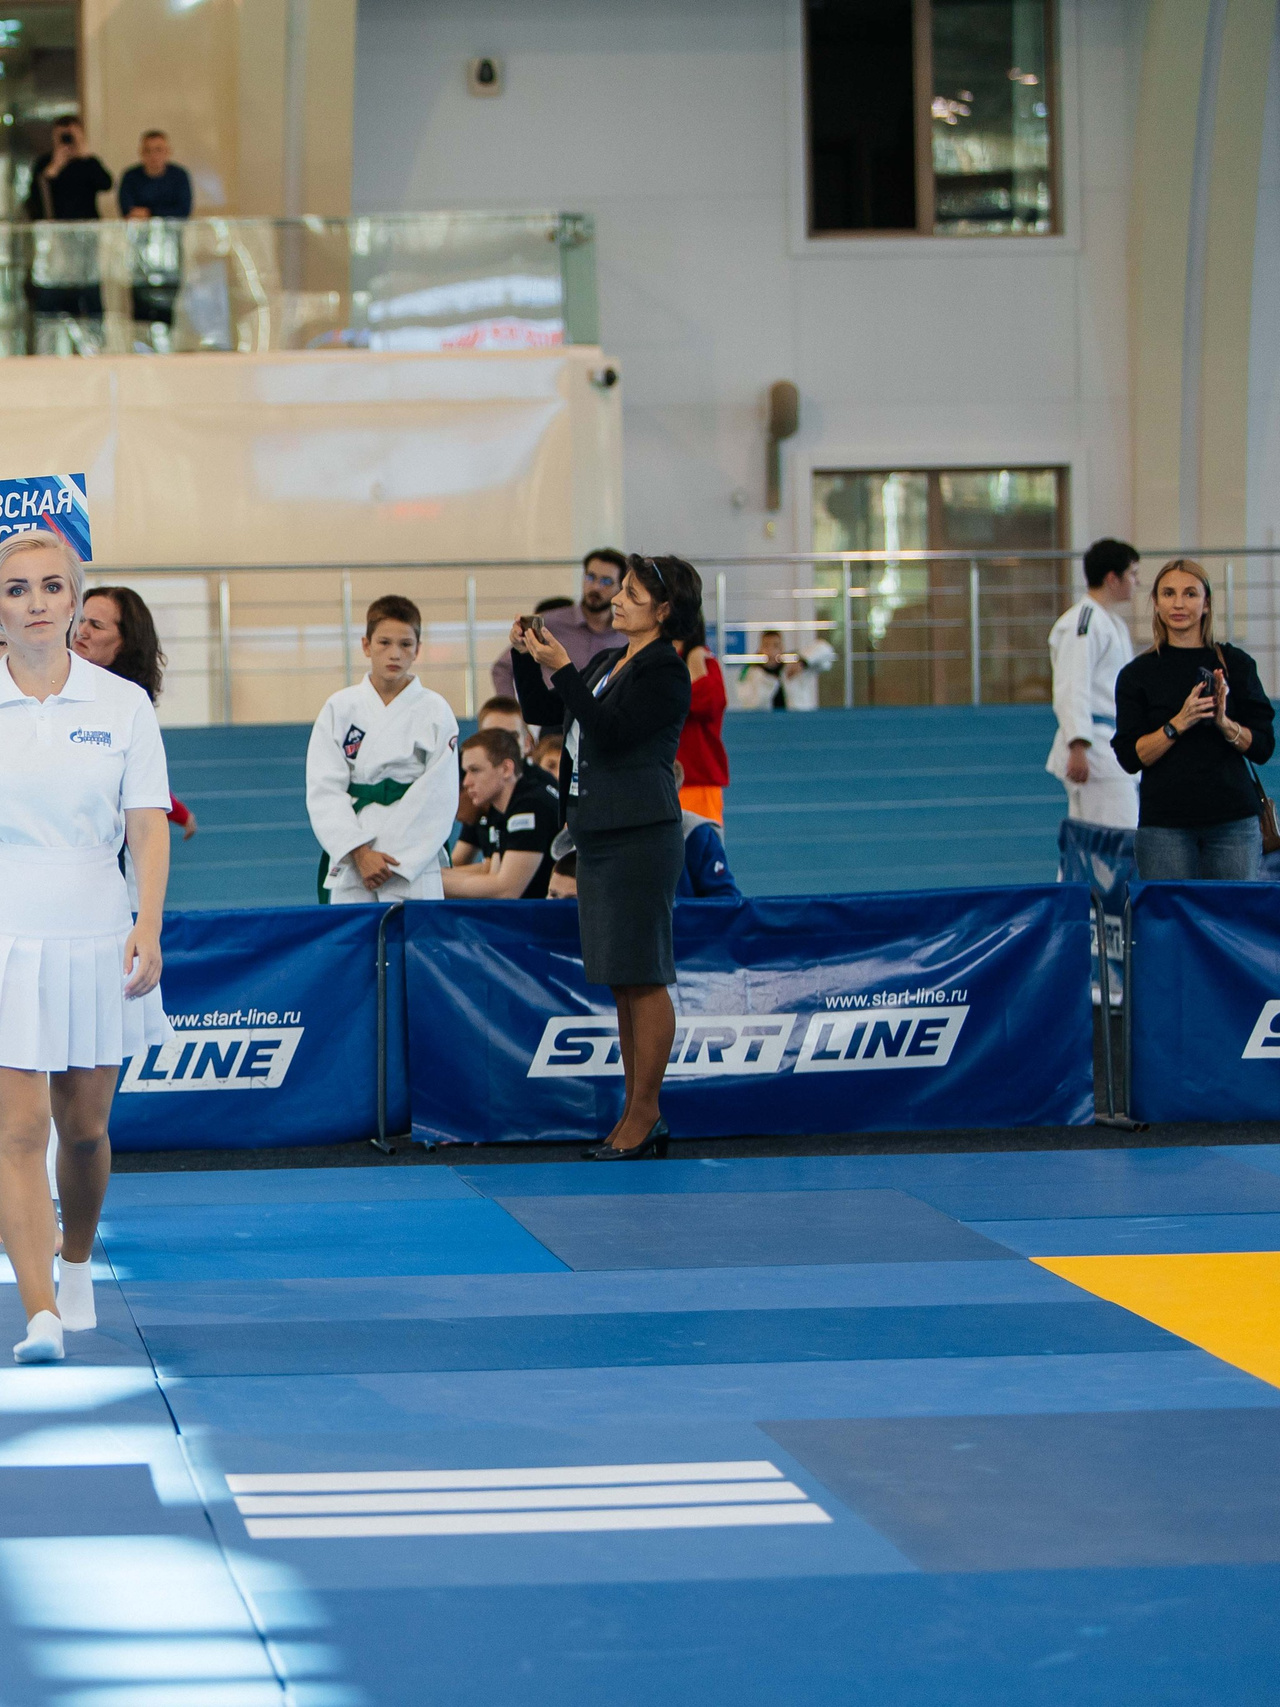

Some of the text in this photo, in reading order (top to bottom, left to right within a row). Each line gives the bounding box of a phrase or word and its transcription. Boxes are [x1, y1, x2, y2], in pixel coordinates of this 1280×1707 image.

[825, 987, 968, 1009] www.start-line.ru
[167, 1009, 302, 1028] ww.start-line.ru
[810, 1016, 951, 1061] LINE
[138, 1040, 282, 1080] LINE
